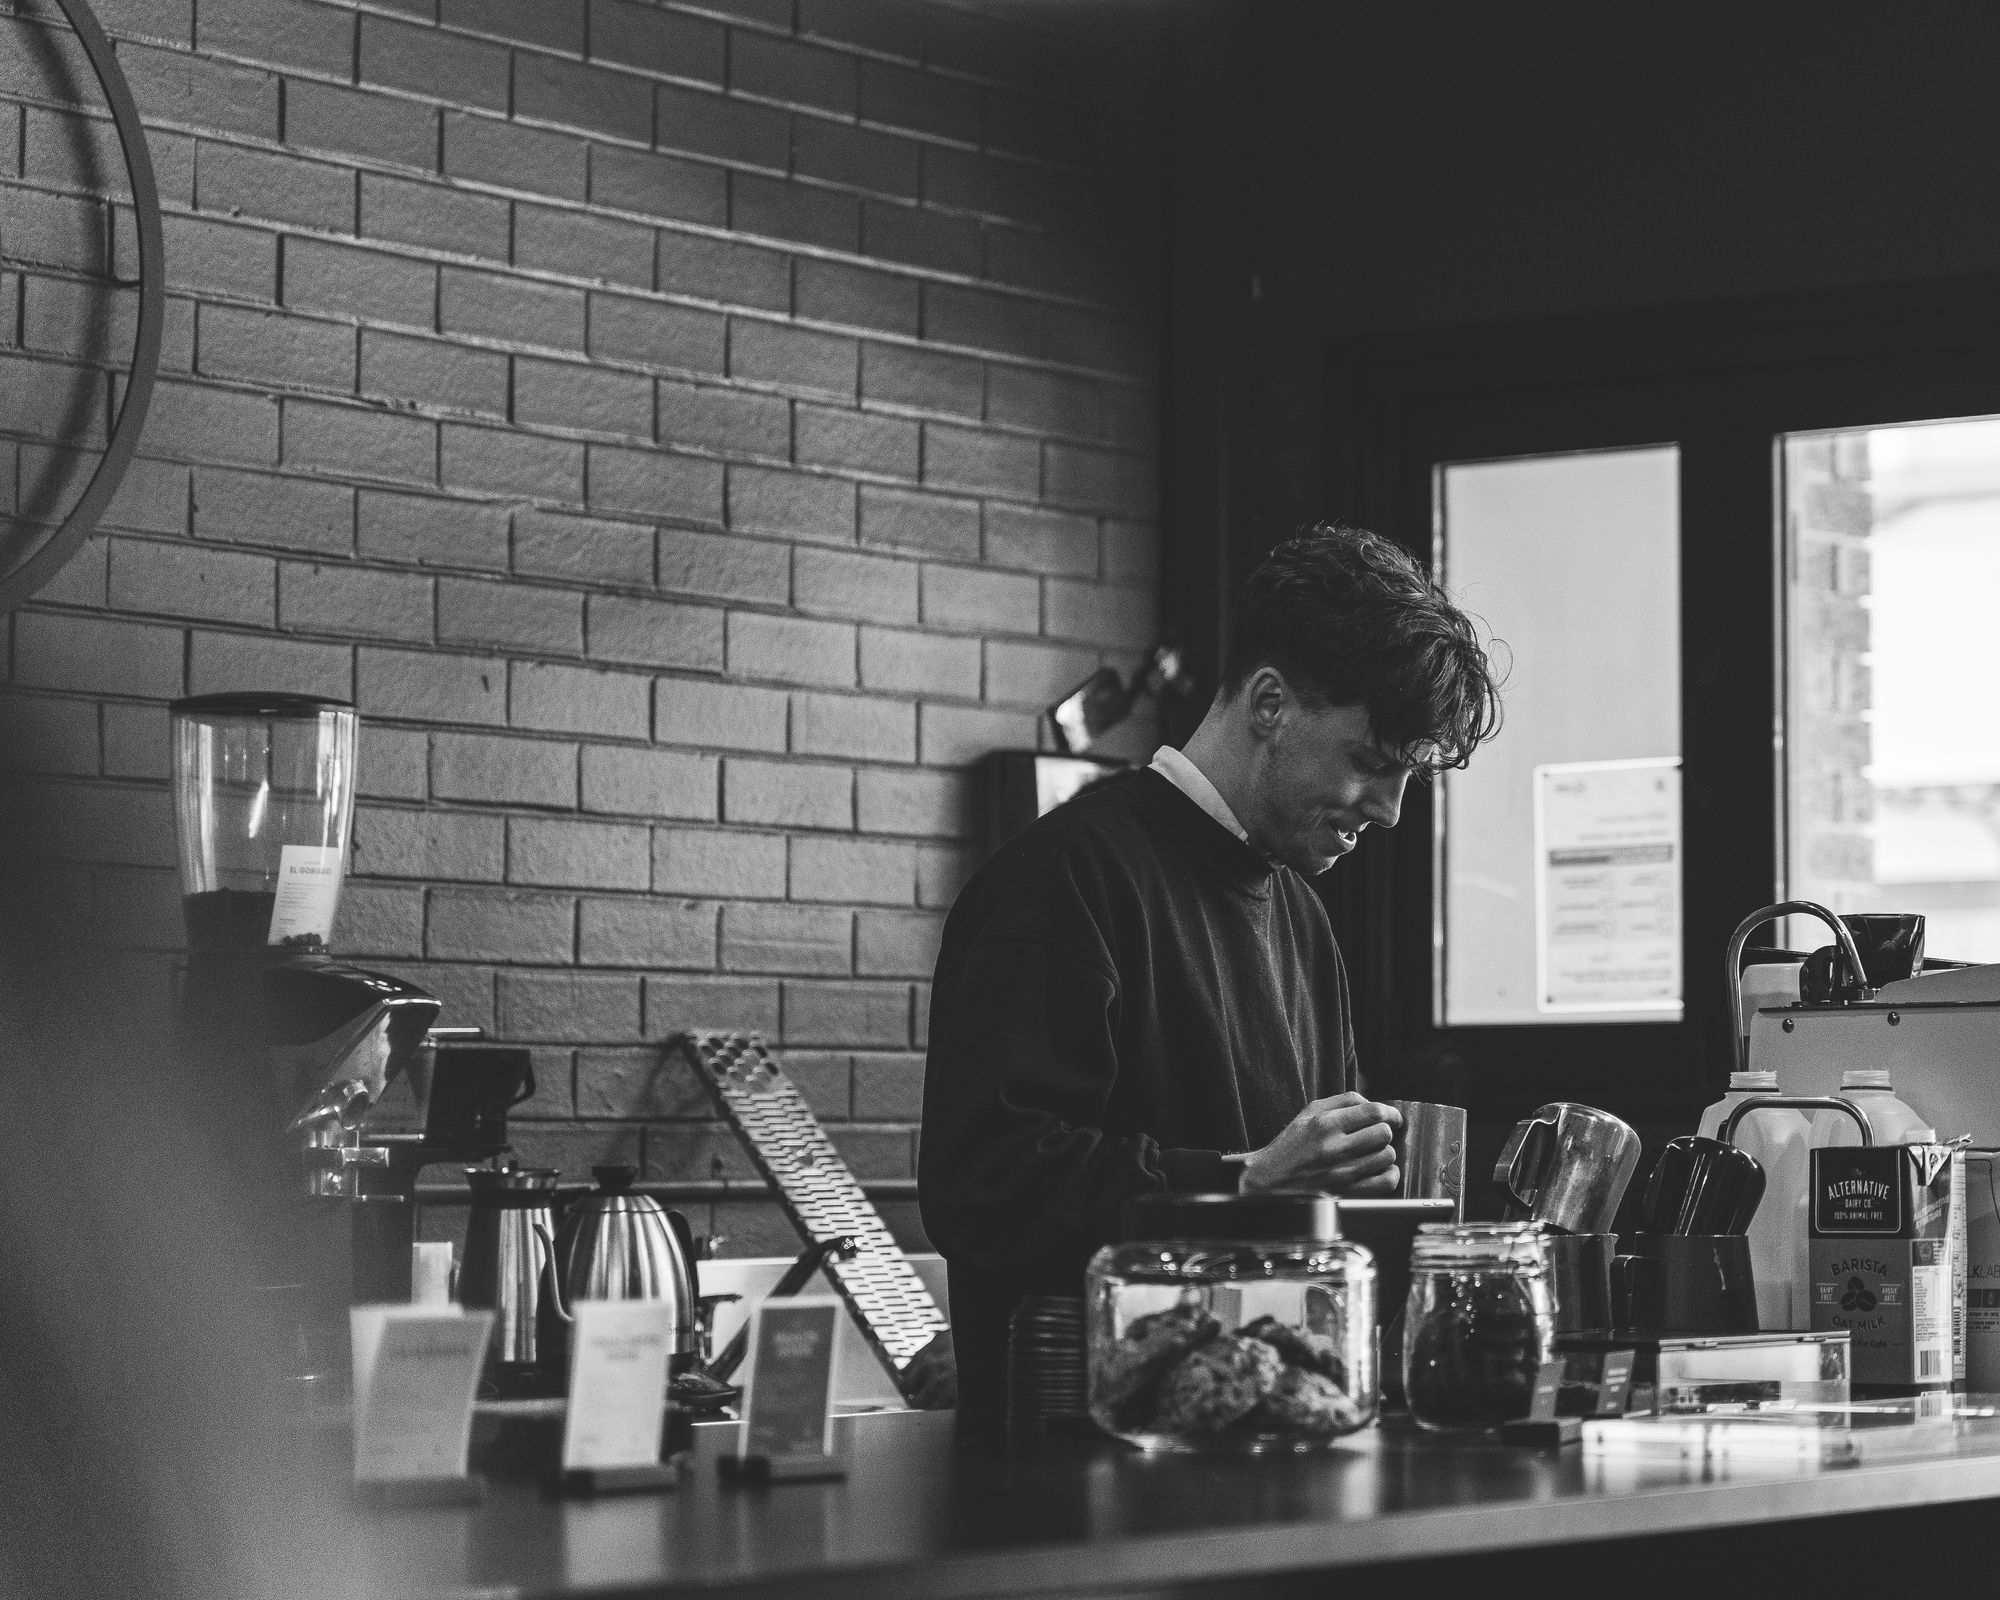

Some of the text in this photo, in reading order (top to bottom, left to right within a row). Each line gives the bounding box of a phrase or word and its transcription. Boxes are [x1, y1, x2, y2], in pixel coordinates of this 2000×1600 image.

[1828, 1180, 1890, 1200] ALTERNATIVE
[1844, 1199, 1862, 1208] DAIRY
[1834, 1211, 1883, 1220] 100% ANIMAL FREE
[1831, 1258, 1887, 1277] BARISTA
[1819, 1286, 1834, 1295] DAIRY
[1820, 1294, 1832, 1302] FREE
[1832, 1315, 1885, 1331] OAT MILK
